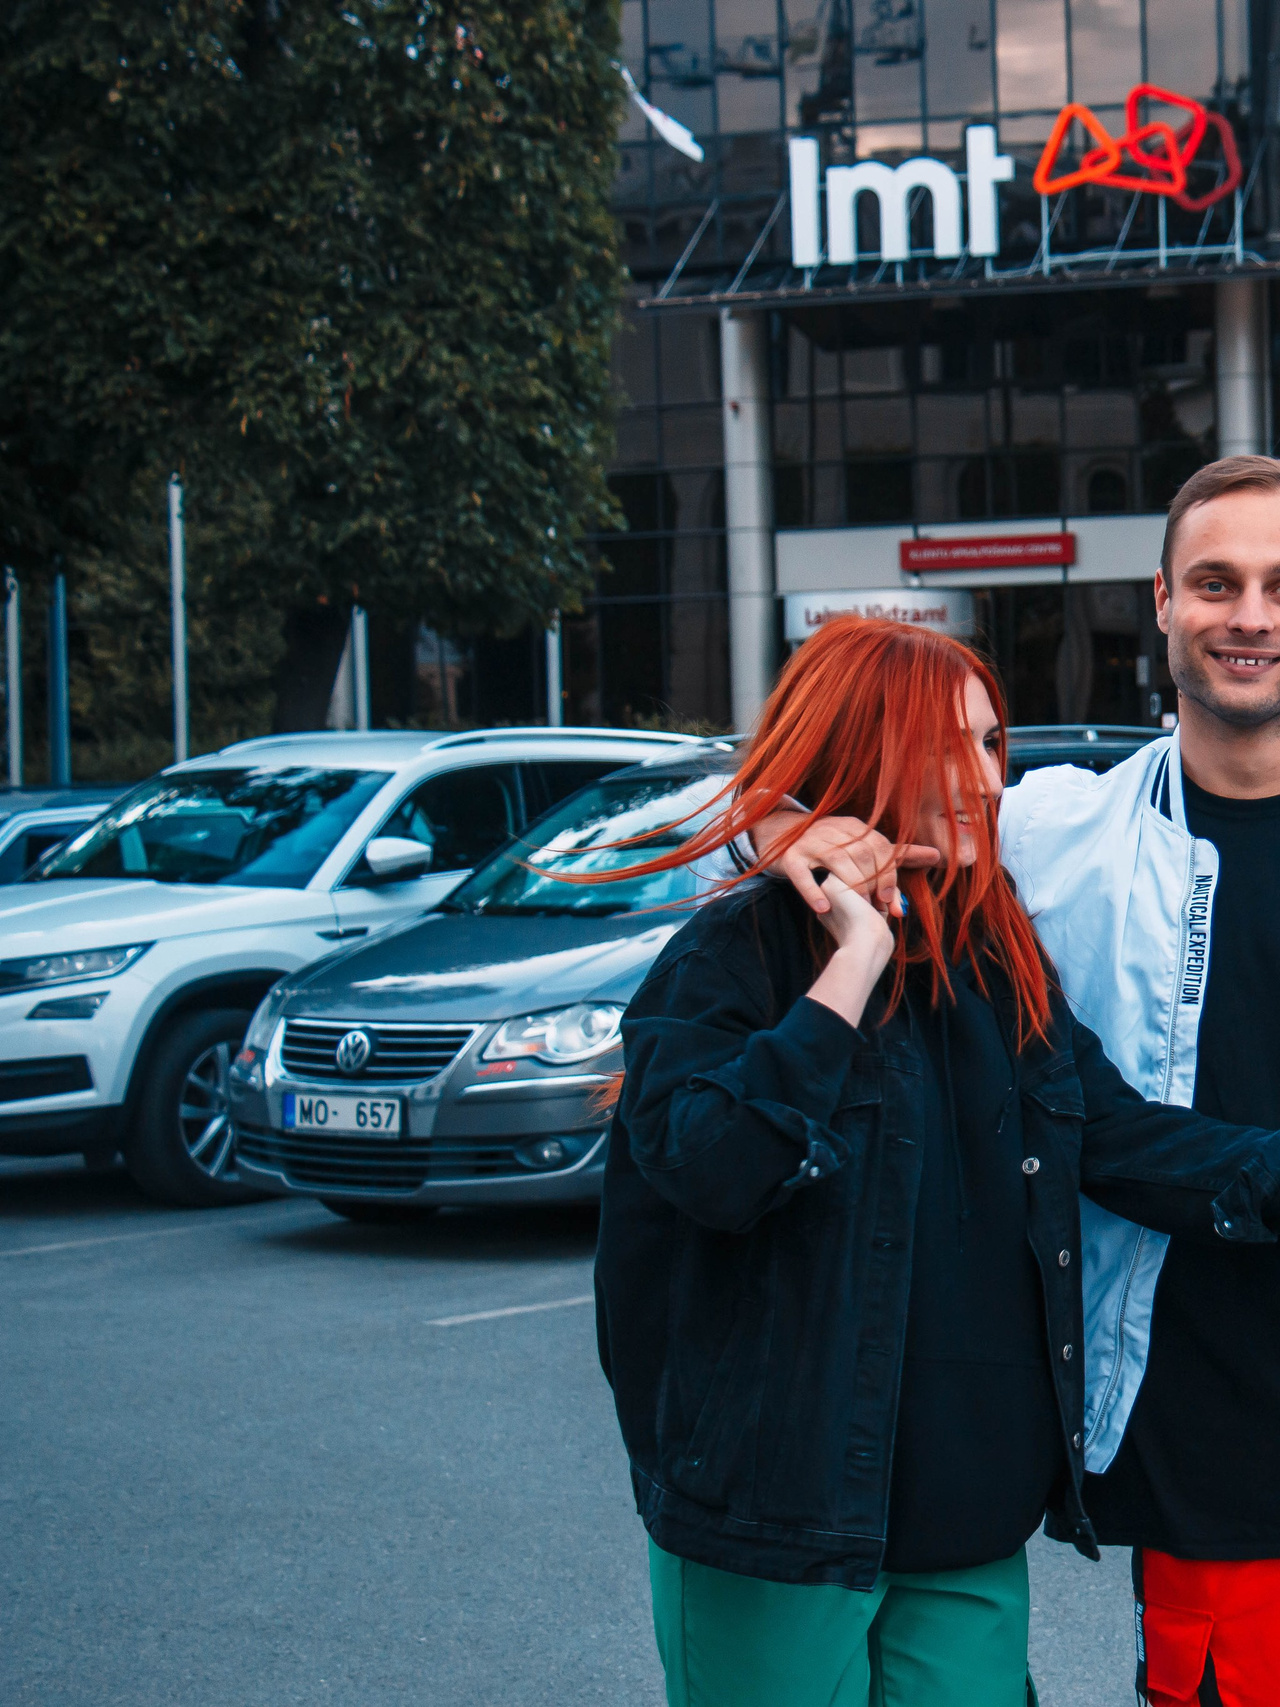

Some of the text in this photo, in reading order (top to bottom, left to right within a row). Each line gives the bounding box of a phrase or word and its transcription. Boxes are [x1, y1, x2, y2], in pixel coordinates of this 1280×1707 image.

[789, 123, 1015, 268] lmt
[1181, 874, 1213, 1005] NAUTICAL EXPEDITION
